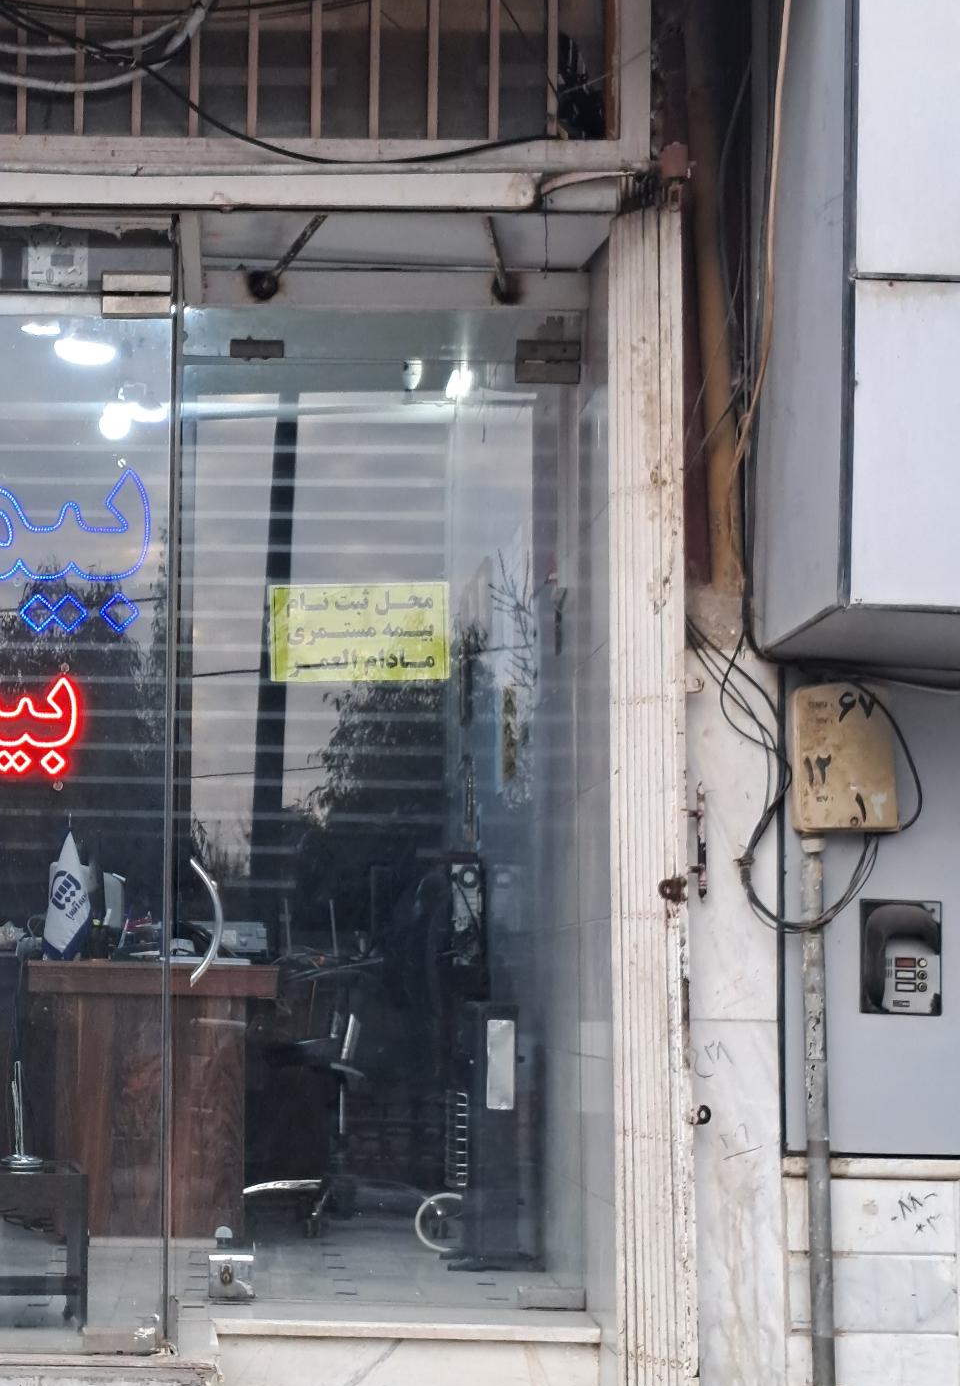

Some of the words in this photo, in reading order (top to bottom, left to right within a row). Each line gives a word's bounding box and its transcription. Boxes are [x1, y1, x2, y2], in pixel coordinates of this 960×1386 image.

[287, 591, 328, 618] نام
[335, 588, 369, 616] ثبت
[375, 589, 434, 615] محل
[287, 622, 377, 645] مستمری
[382, 623, 434, 642] بیمه
[287, 648, 358, 678] العمر
[365, 648, 435, 676] مادام
